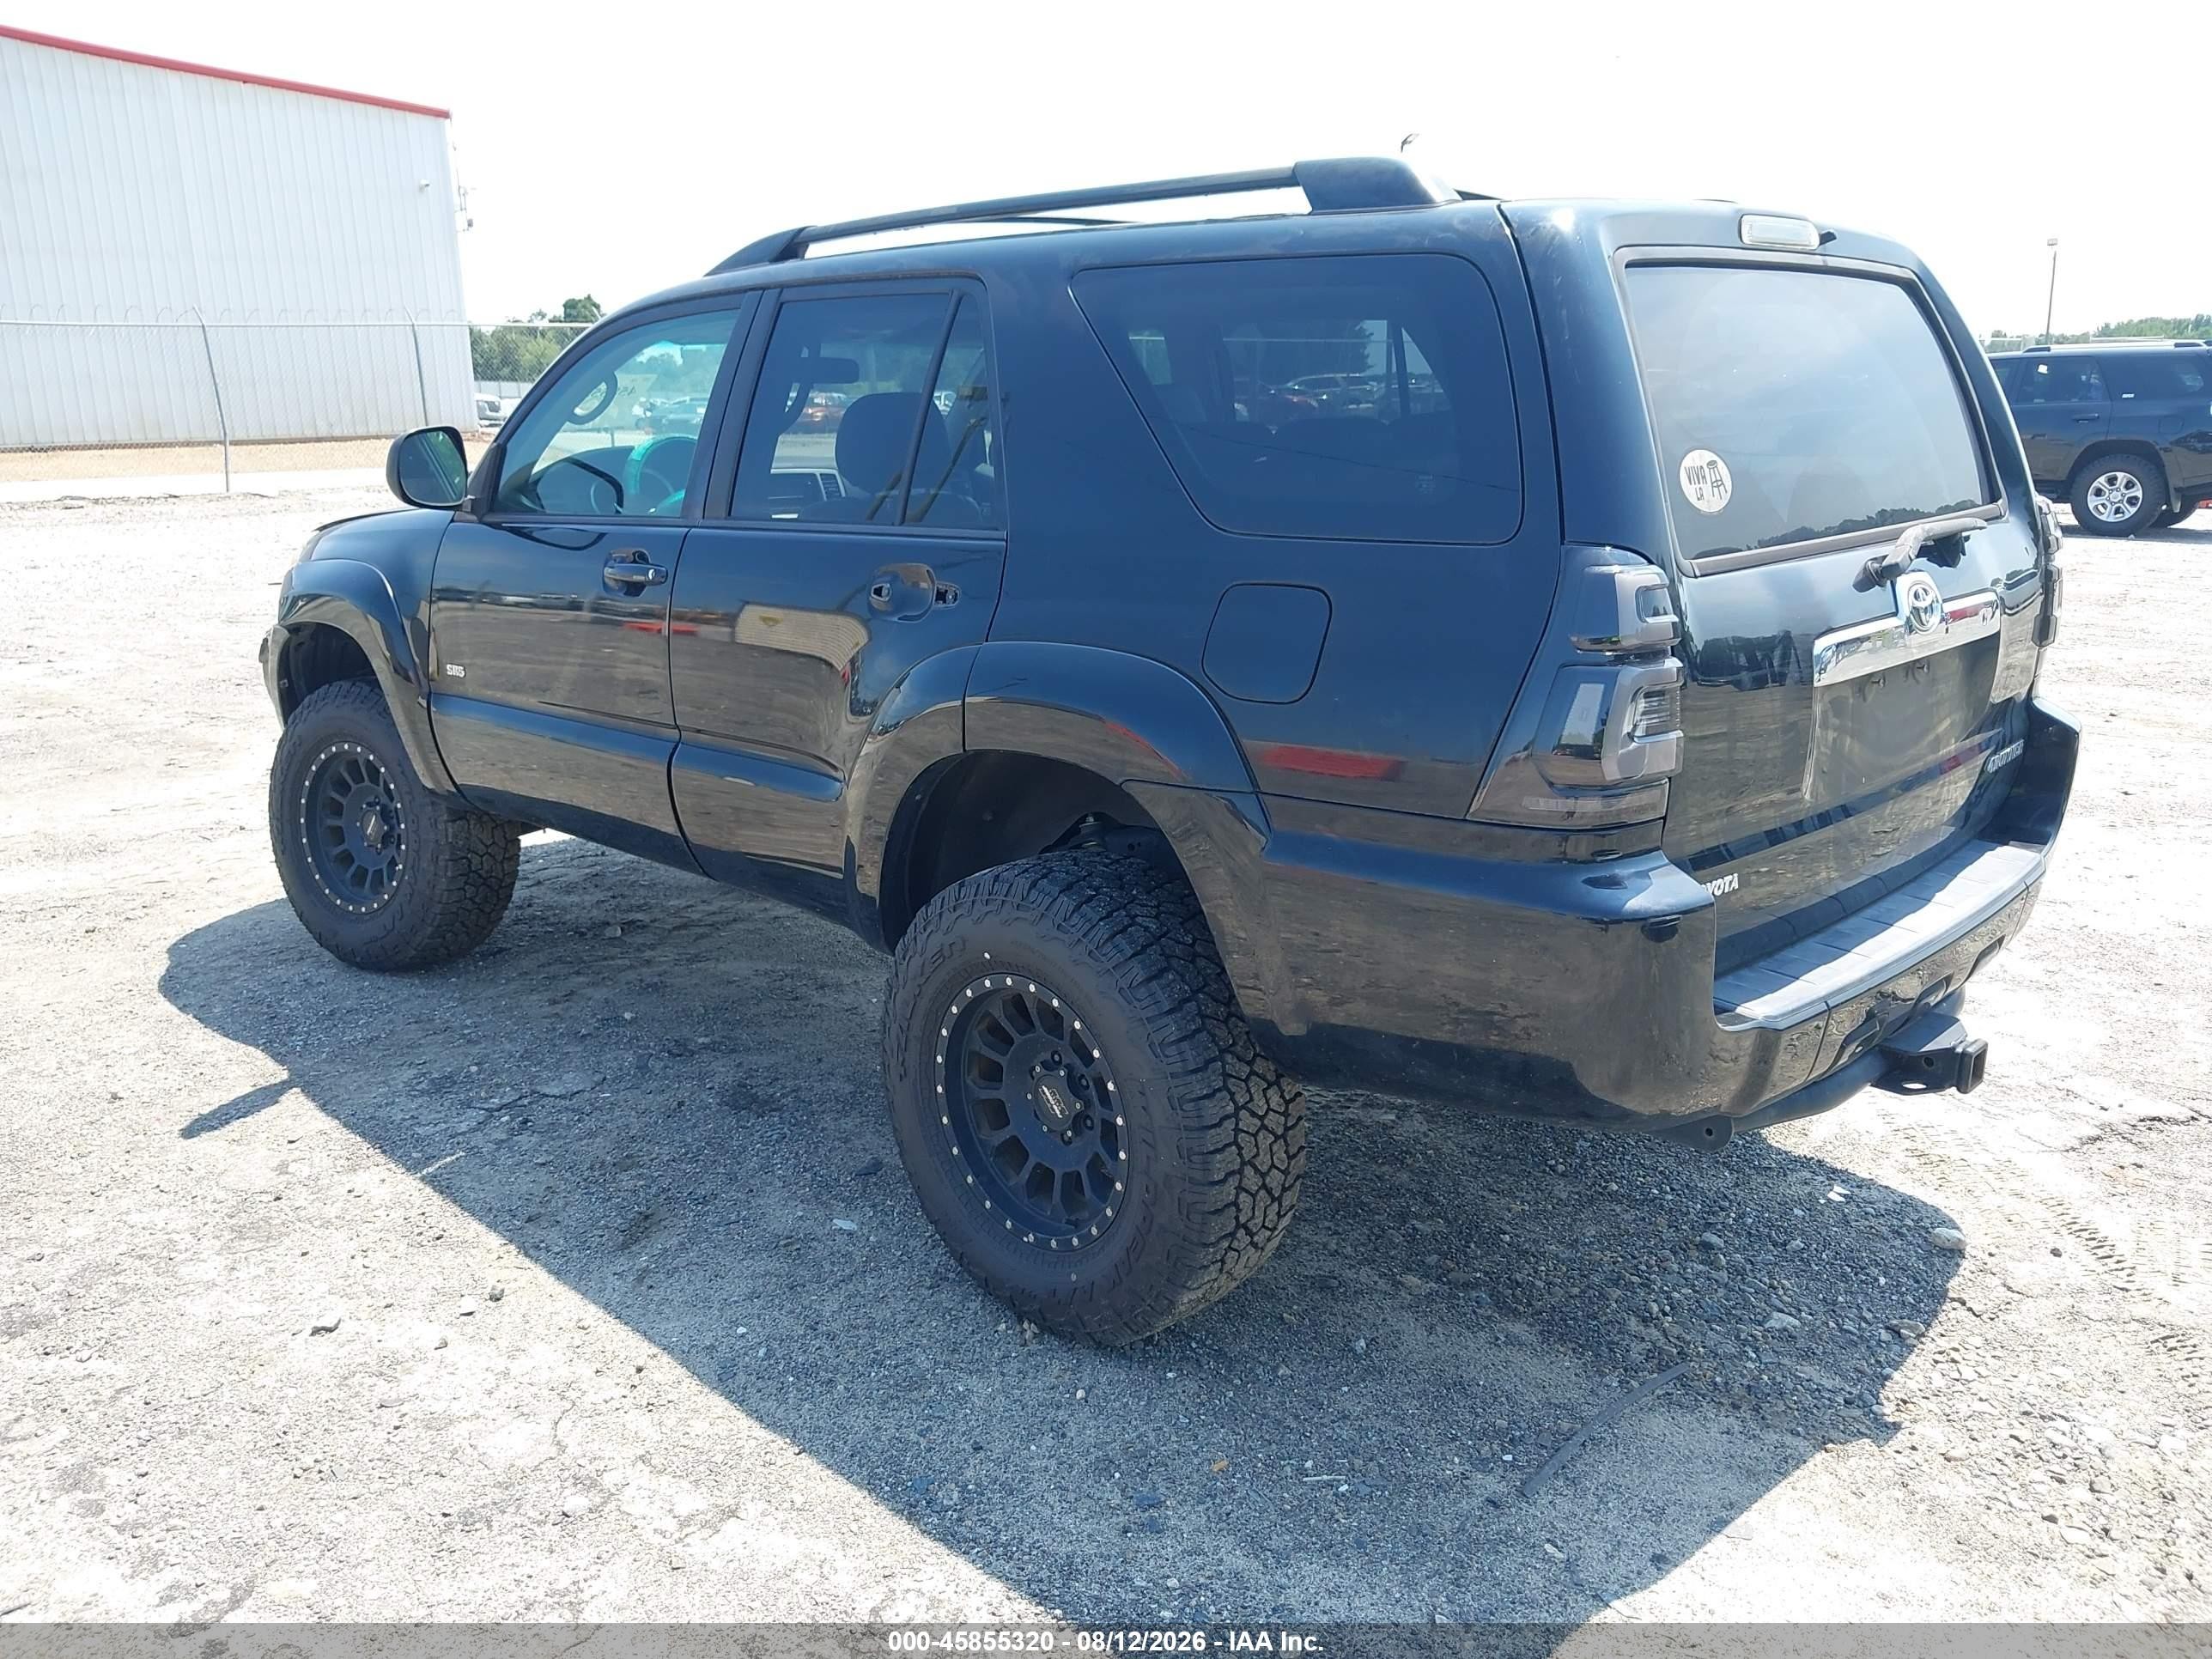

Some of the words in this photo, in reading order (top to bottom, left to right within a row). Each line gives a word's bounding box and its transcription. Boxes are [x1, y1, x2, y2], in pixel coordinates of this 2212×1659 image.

[1684, 465, 1707, 486] VIVA
[1695, 487, 1705, 501] LA
[1704, 872, 1739, 896] YOTA
